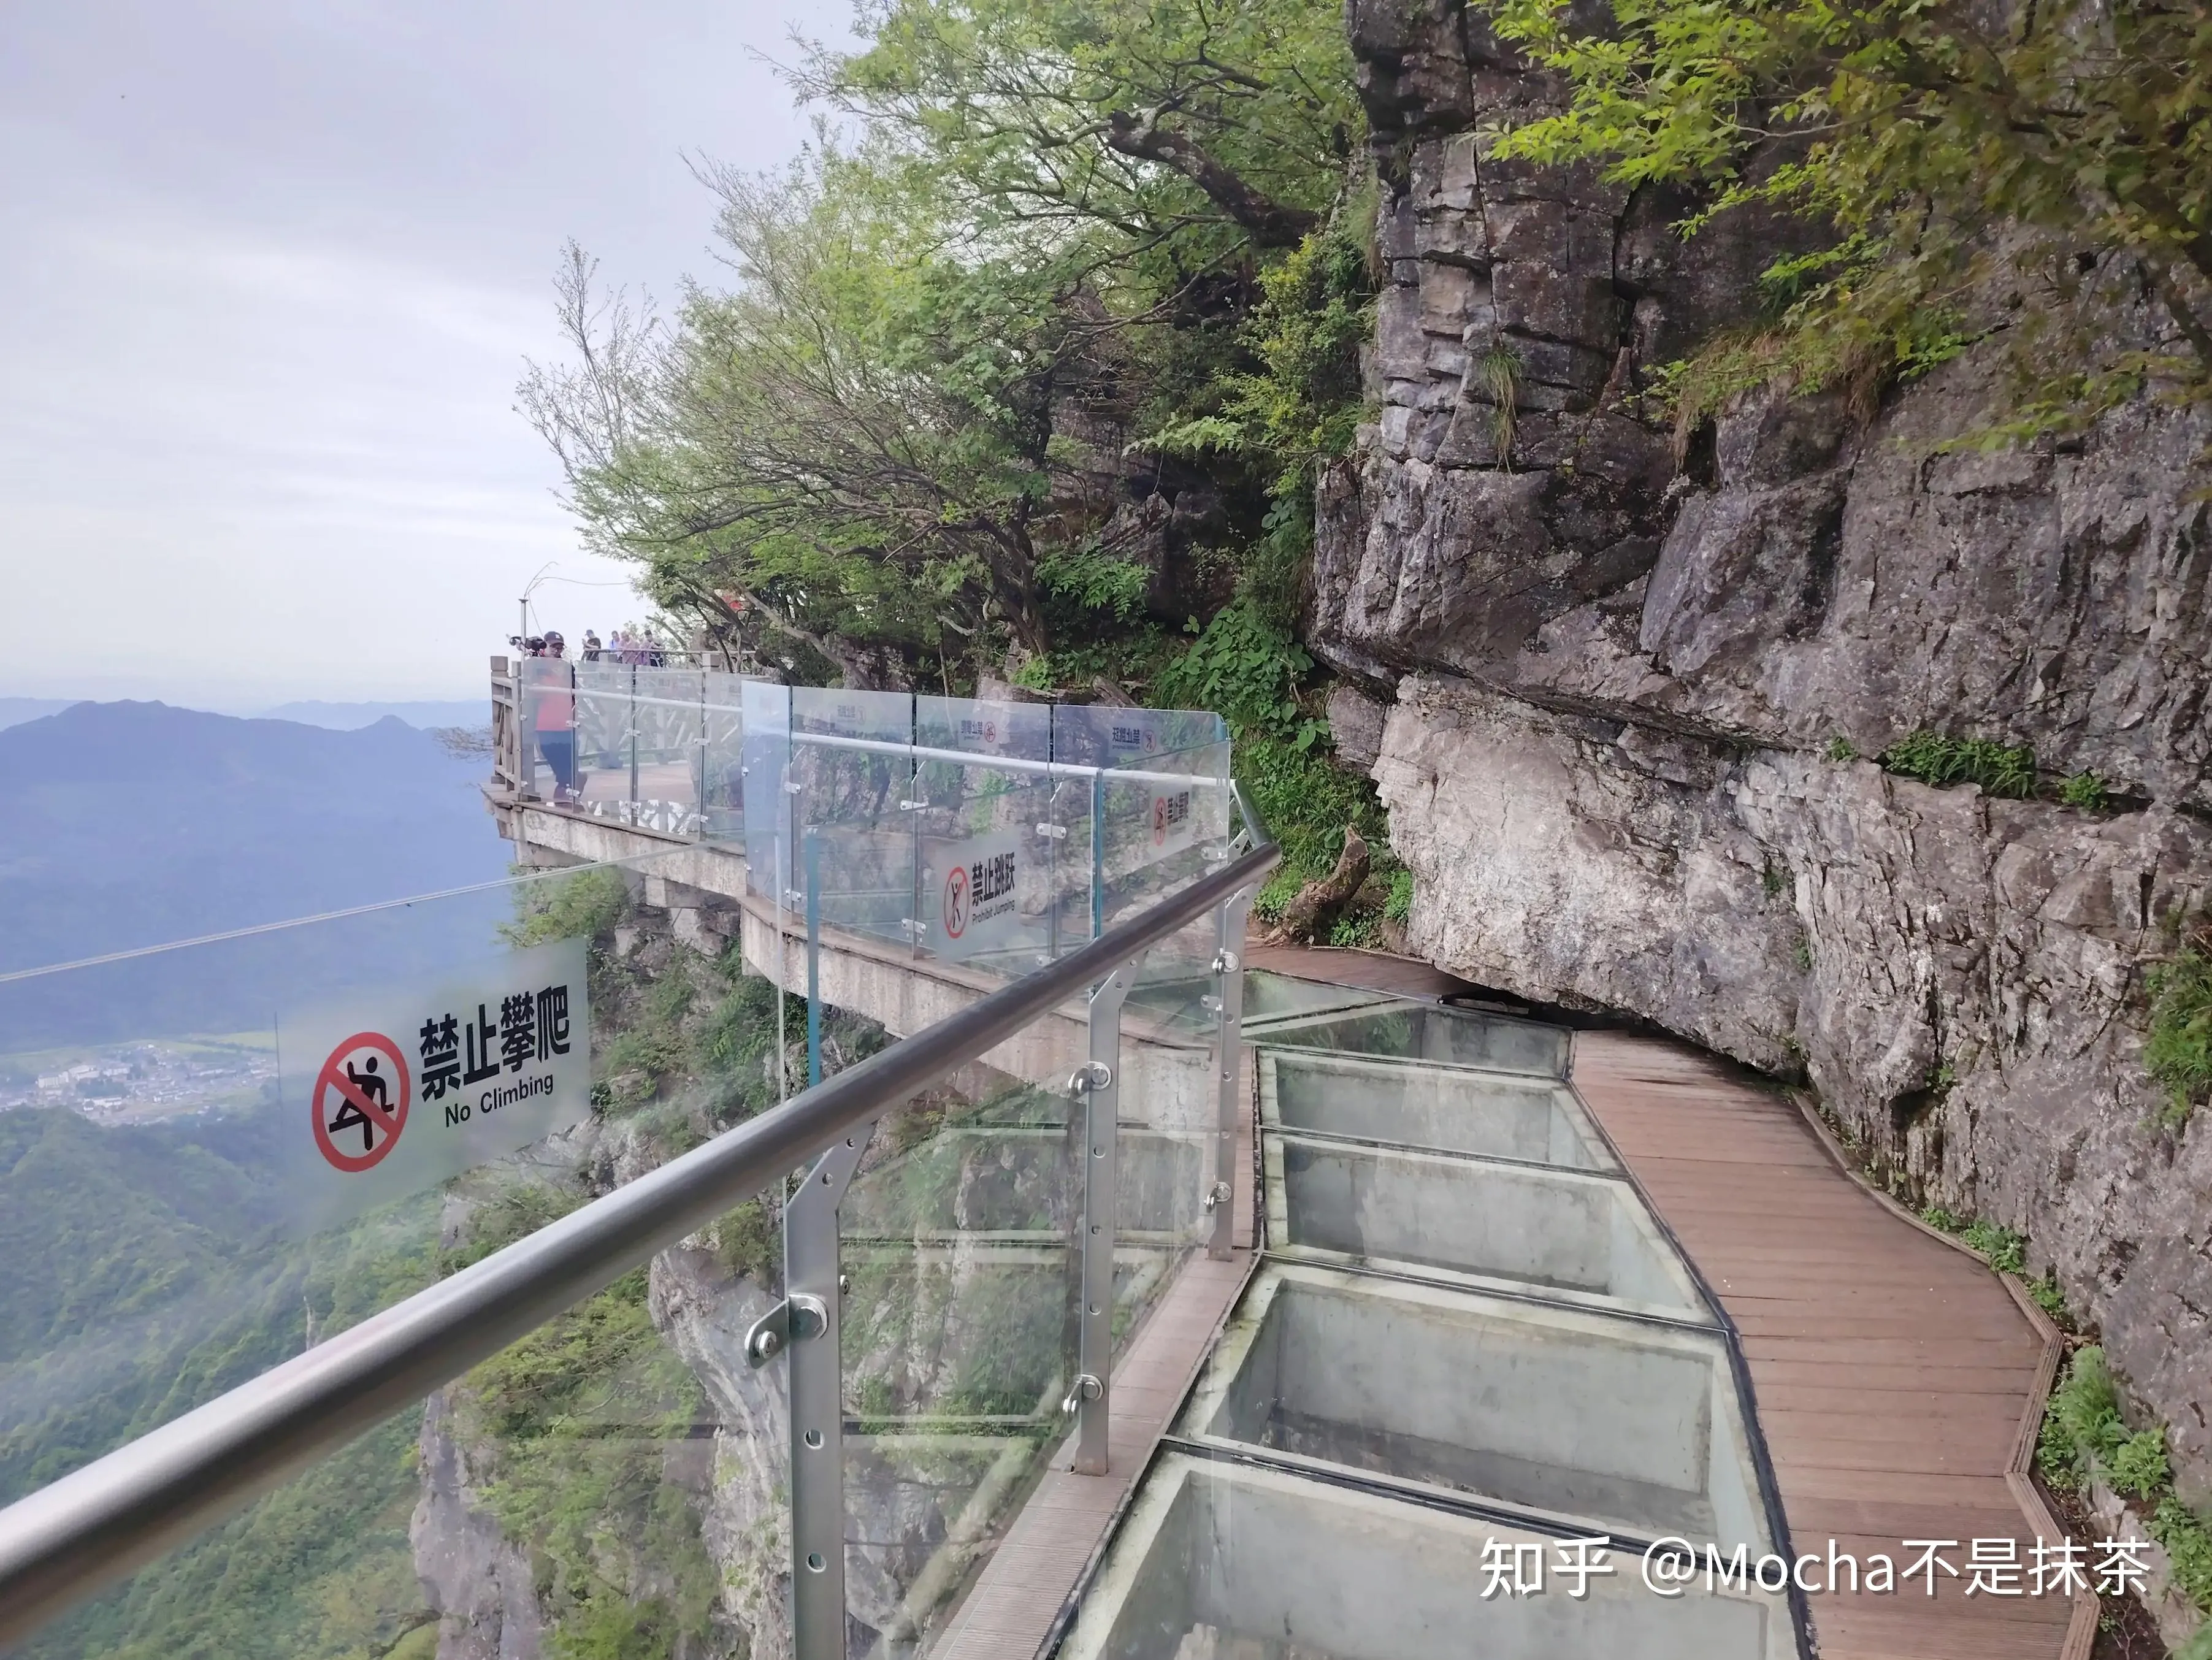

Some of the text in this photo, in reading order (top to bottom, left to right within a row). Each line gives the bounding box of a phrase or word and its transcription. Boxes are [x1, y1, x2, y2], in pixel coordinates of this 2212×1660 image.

[972, 851, 1015, 907] 禁止跳跃
[993, 899, 1015, 916] Jumping
[419, 984, 571, 1103] 禁止攀爬
[445, 1074, 554, 1128] No Climbing
